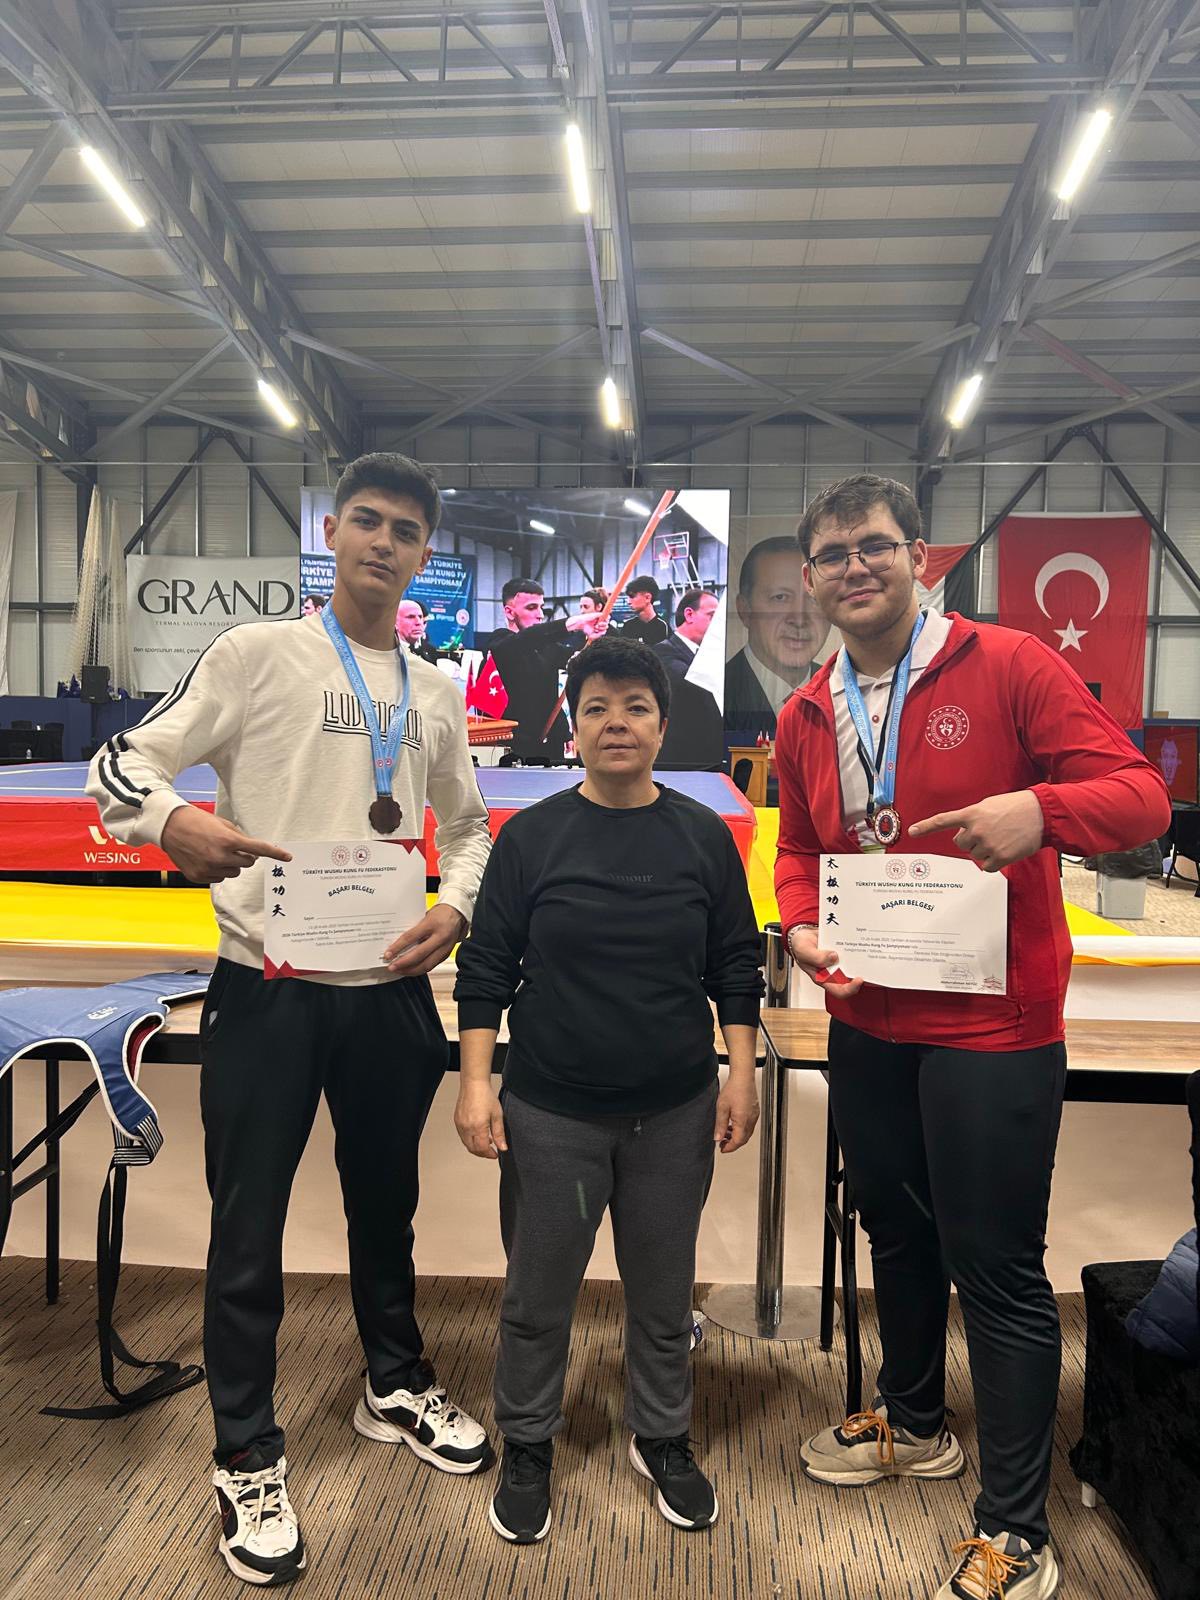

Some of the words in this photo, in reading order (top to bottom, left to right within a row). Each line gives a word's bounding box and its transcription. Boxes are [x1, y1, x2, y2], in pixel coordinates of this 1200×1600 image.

[137, 579, 295, 616] GRAND
[84, 852, 141, 864] WESING
[328, 885, 350, 897] BAŞARI
[351, 884, 376, 895] BELGESİ
[880, 899, 906, 911] BAŞARI
[906, 899, 936, 912] BELGESİ
